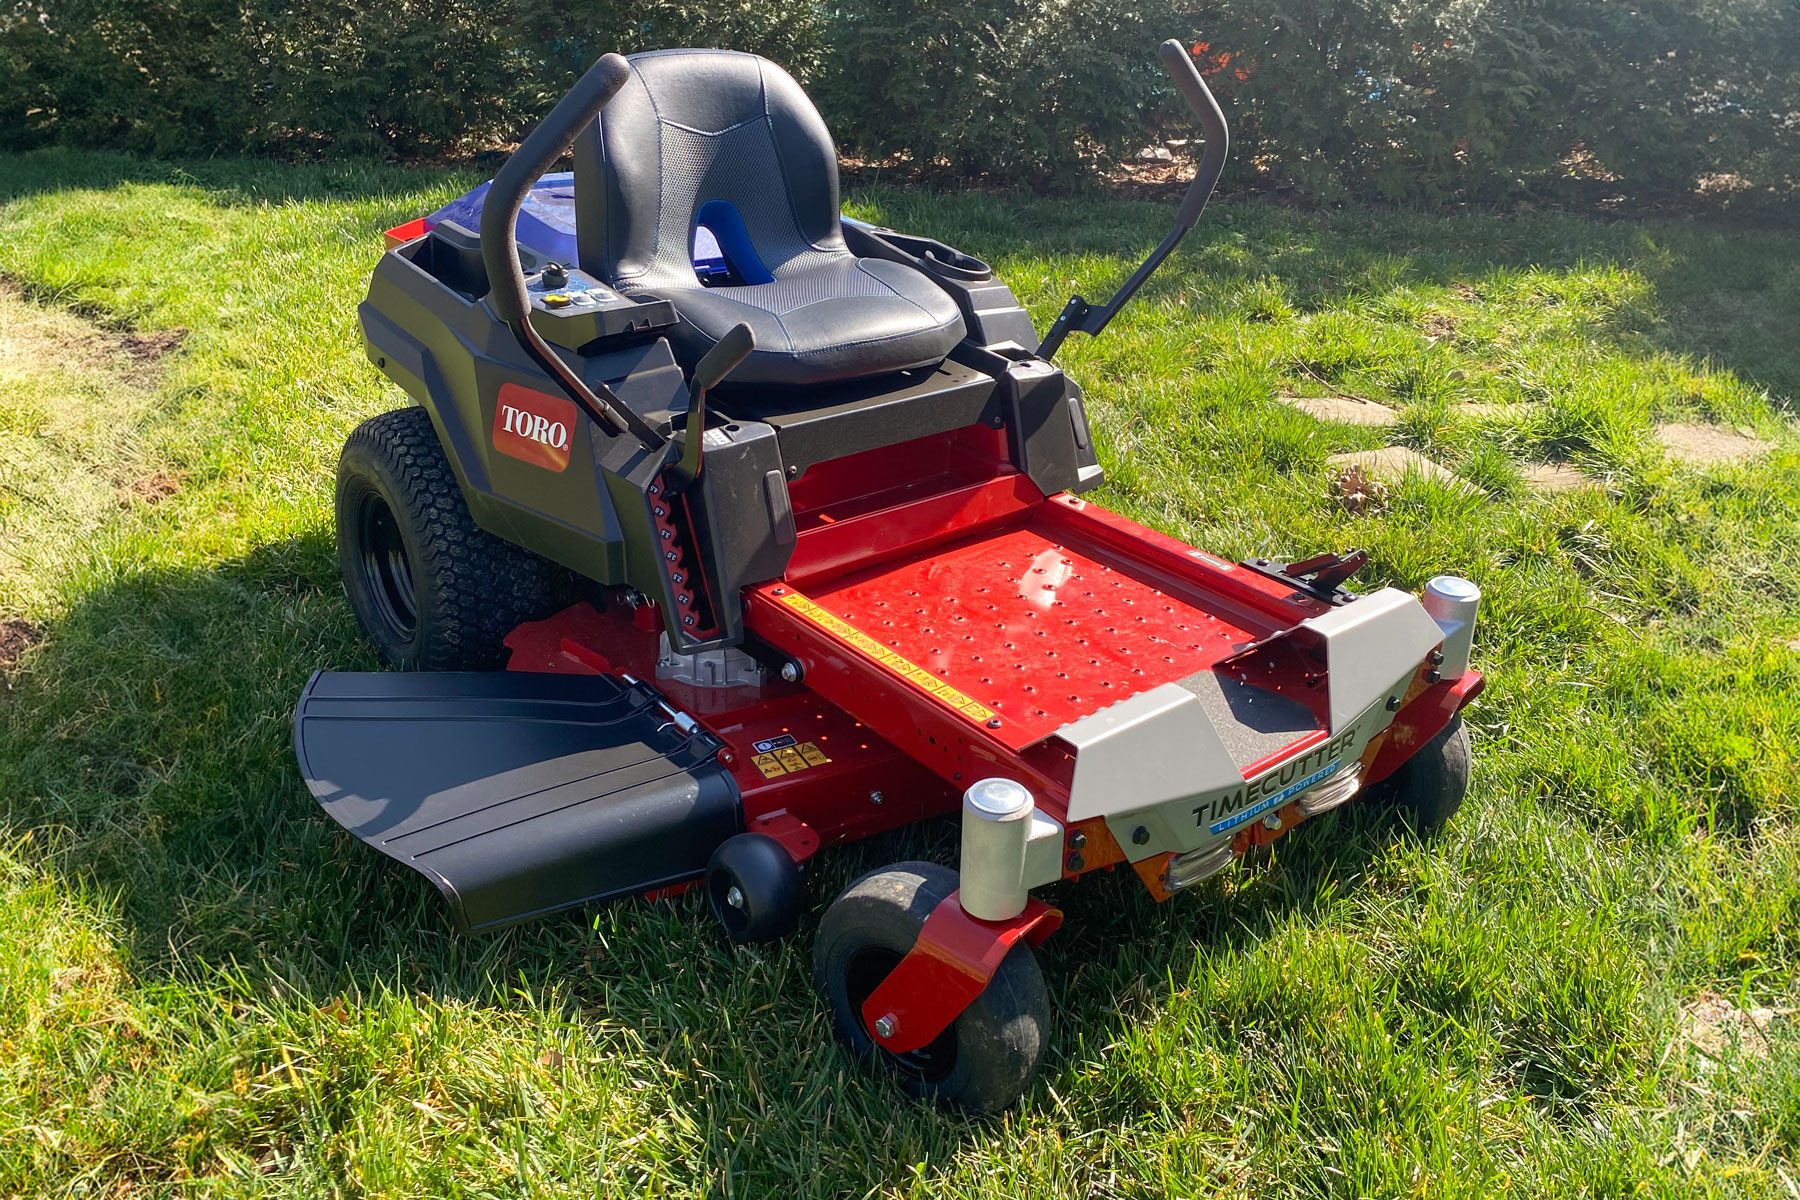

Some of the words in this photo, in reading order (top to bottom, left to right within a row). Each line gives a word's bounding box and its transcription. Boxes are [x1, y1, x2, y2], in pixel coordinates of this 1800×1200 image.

[502, 404, 567, 449] TORO
[649, 485, 659, 493] 4.5
[654, 507, 664, 515] 4.0
[660, 529, 671, 538] 3.5
[667, 552, 677, 561] 3.0
[673, 573, 682, 583] 2.5
[678, 594, 688, 603] 2.0
[684, 616, 693, 625] 1.5
[1192, 730, 1355, 827] TIMECUTTER
[1218, 801, 1270, 831] LITHIUM
[1288, 764, 1337, 795] POWERED
